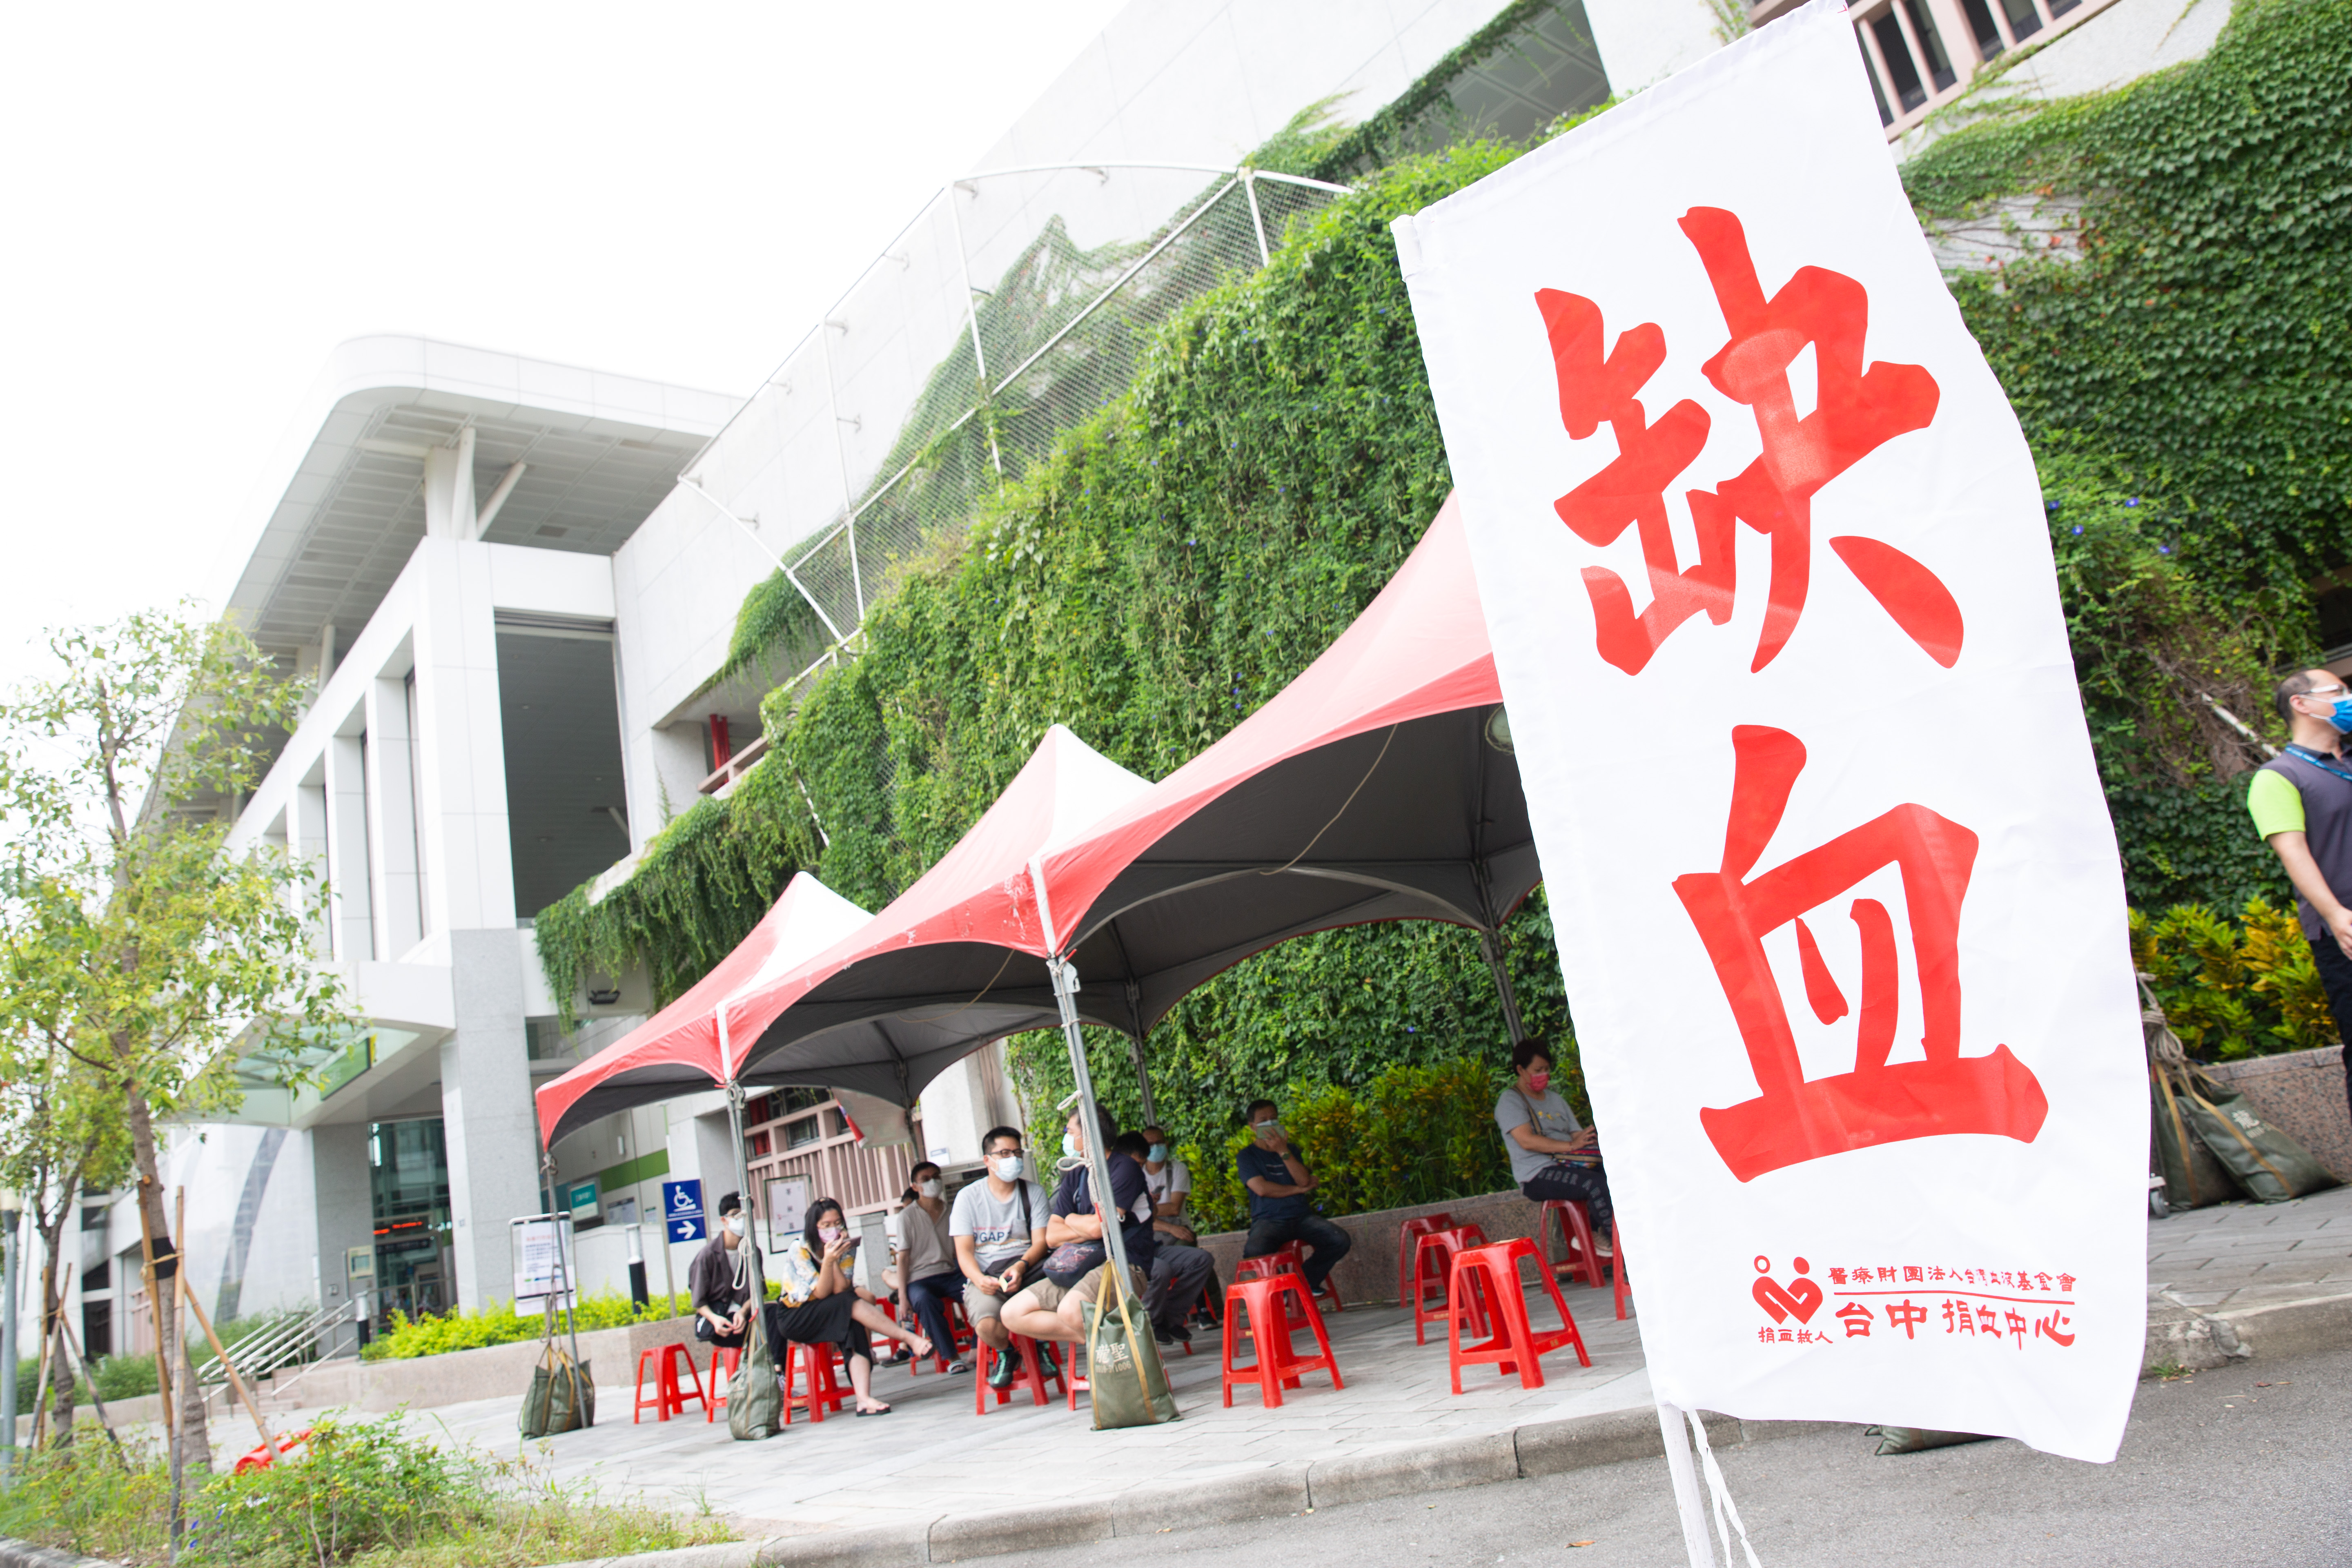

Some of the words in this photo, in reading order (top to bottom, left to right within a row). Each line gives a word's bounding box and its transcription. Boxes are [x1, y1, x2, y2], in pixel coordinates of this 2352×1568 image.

[1535, 206, 2049, 1183] 缺血
[1538, 1169, 1579, 1185] UNDER
[1582, 1179, 1613, 1232] ARMOU
[980, 1232, 1004, 1242] GAP
[1758, 1326, 1833, 1344] 捐血救人
[1835, 1298, 2075, 1350] 台中捐血中心
